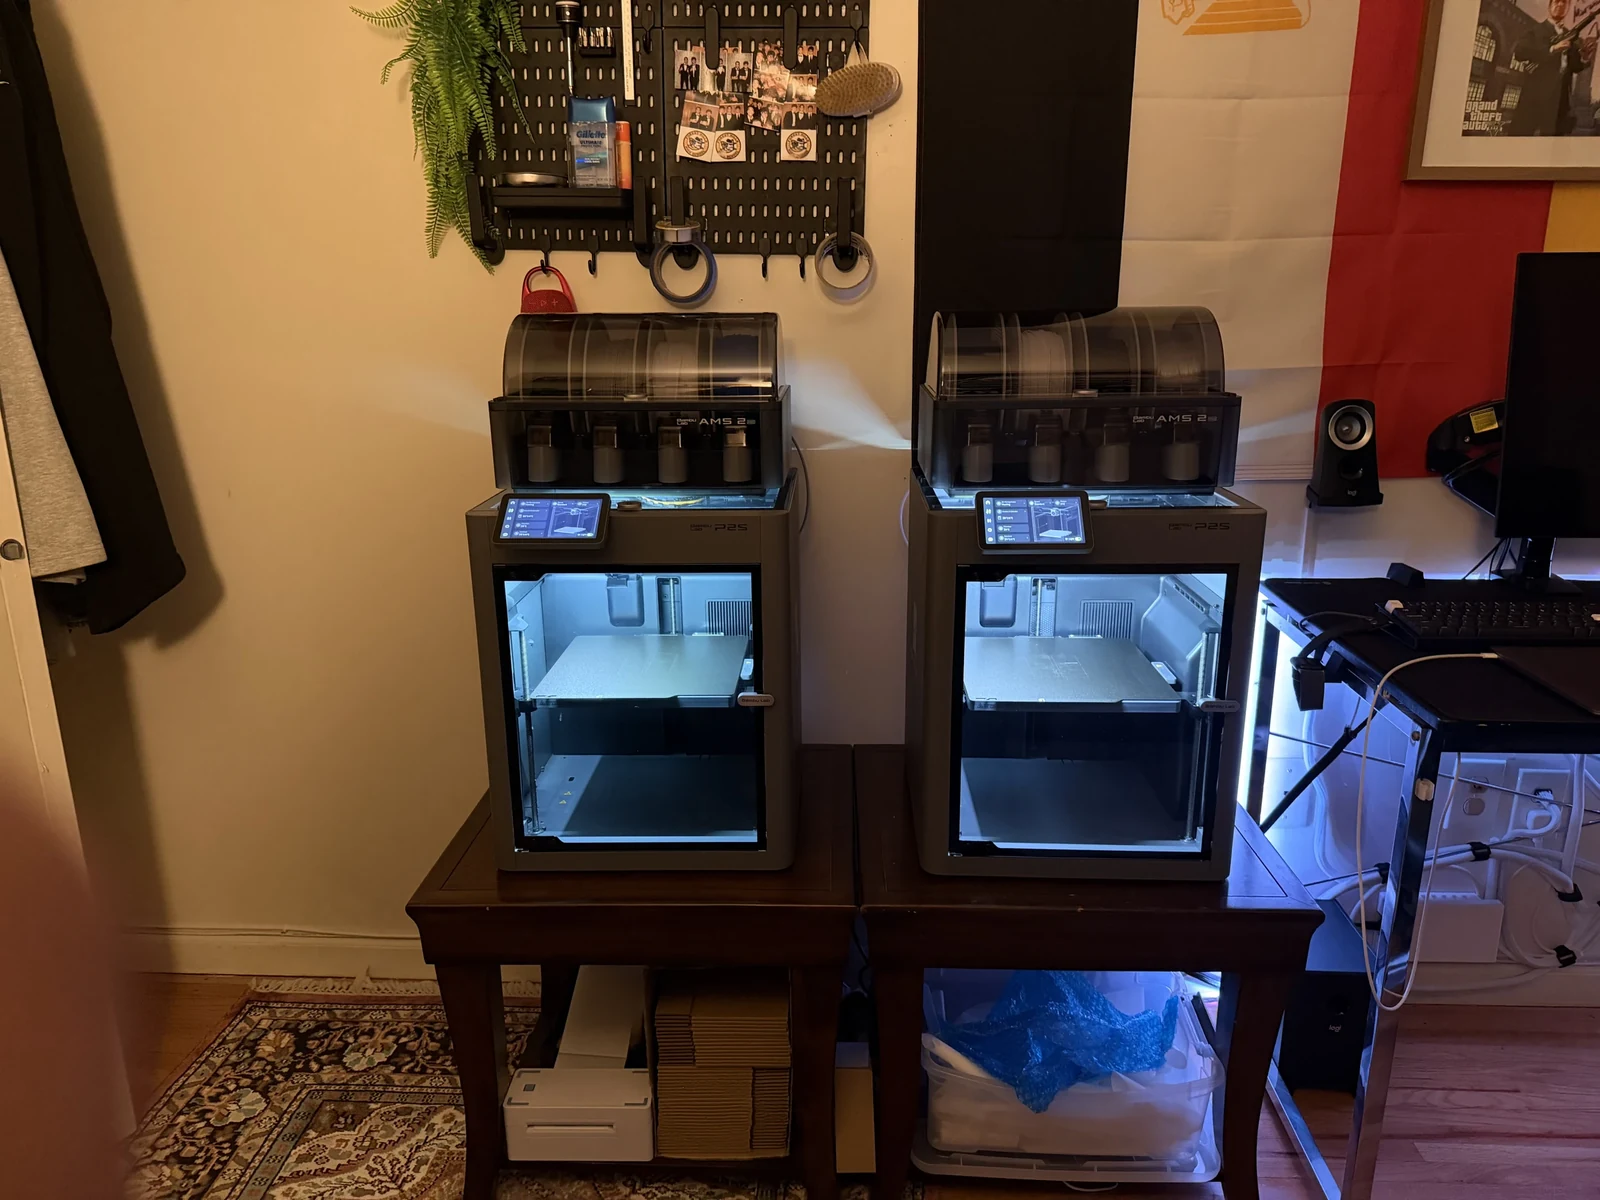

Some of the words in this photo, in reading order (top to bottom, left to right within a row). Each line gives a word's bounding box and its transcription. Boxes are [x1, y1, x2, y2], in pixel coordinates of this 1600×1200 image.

[576, 130, 606, 139] Gillette
[699, 417, 733, 425] AMS
[737, 417, 746, 425] 2
[1156, 414, 1192, 422] AMS
[1197, 414, 1207, 422] 2
[1329, 1024, 1342, 1032] logi
